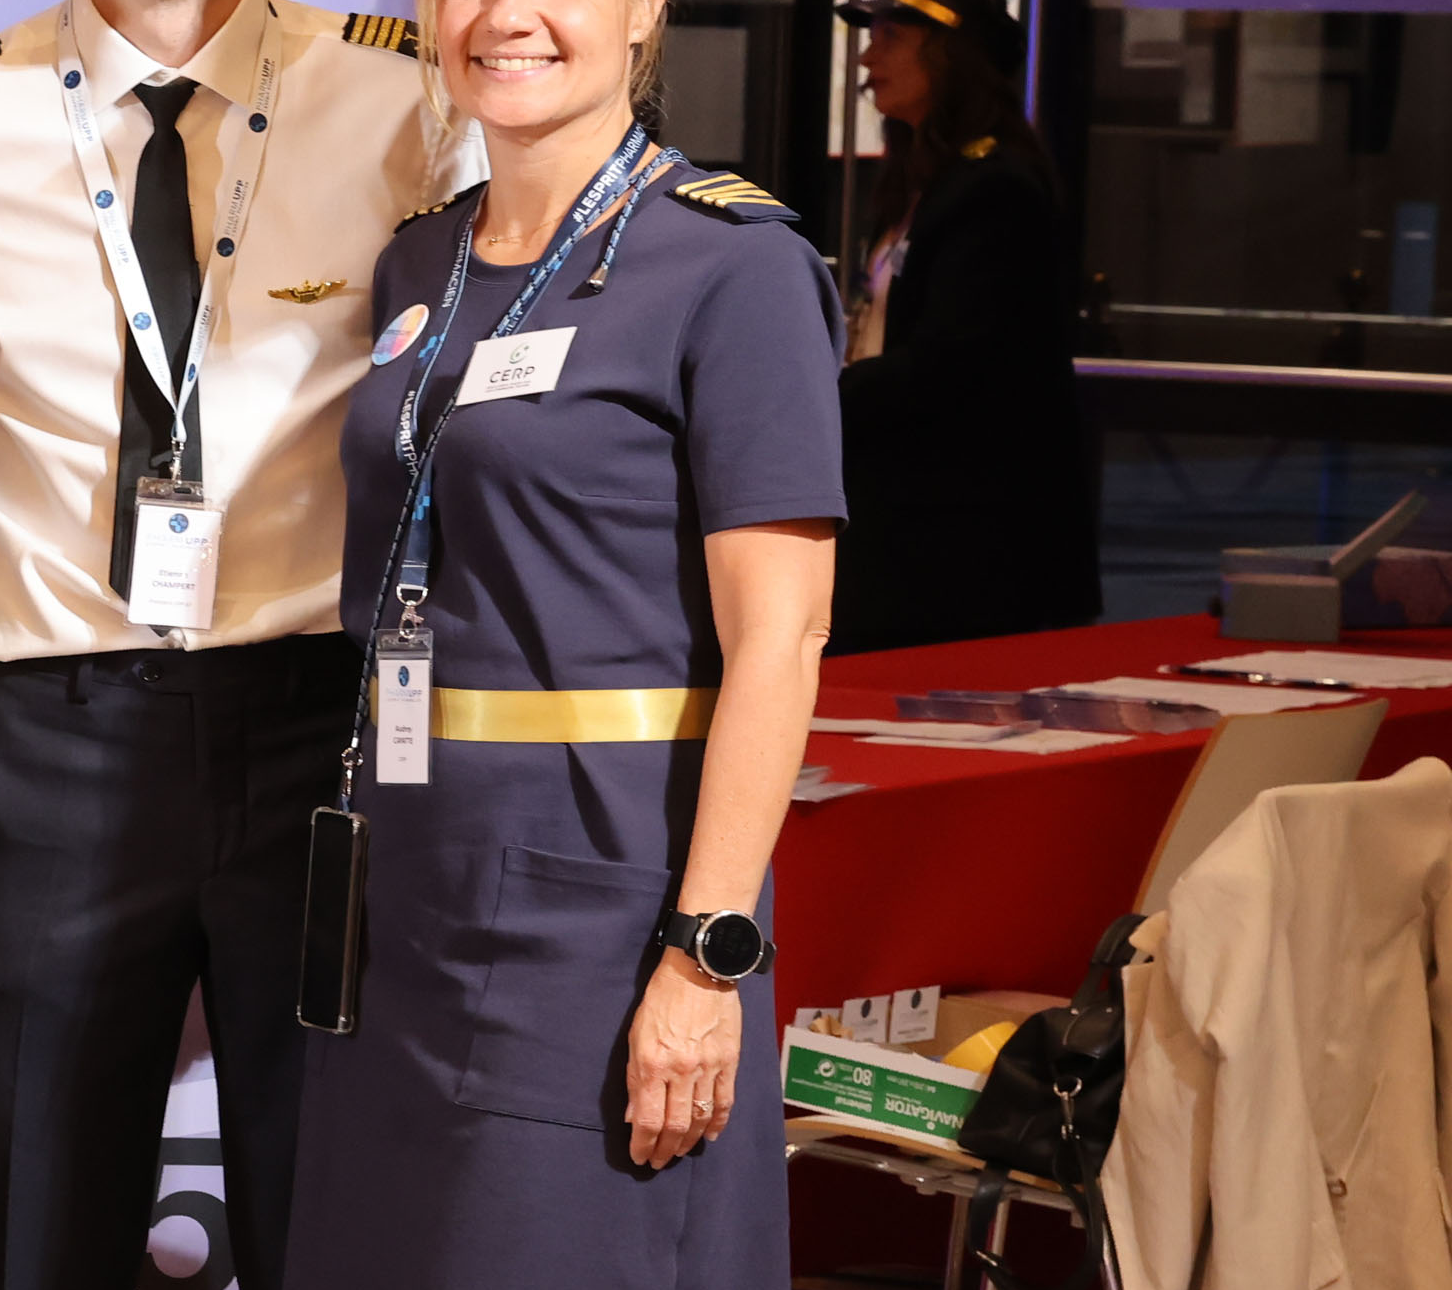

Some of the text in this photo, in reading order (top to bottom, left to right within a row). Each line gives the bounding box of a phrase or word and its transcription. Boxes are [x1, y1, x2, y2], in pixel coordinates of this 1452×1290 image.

[256, 58, 270, 110] PHARMUPP
[224, 180, 243, 236] PHARMUPP
[490, 366, 535, 383] CERP
[852, 1064, 874, 1088] 80
[834, 1095, 873, 1113] Universal
[884, 1097, 964, 1130] NAVIGATOR
